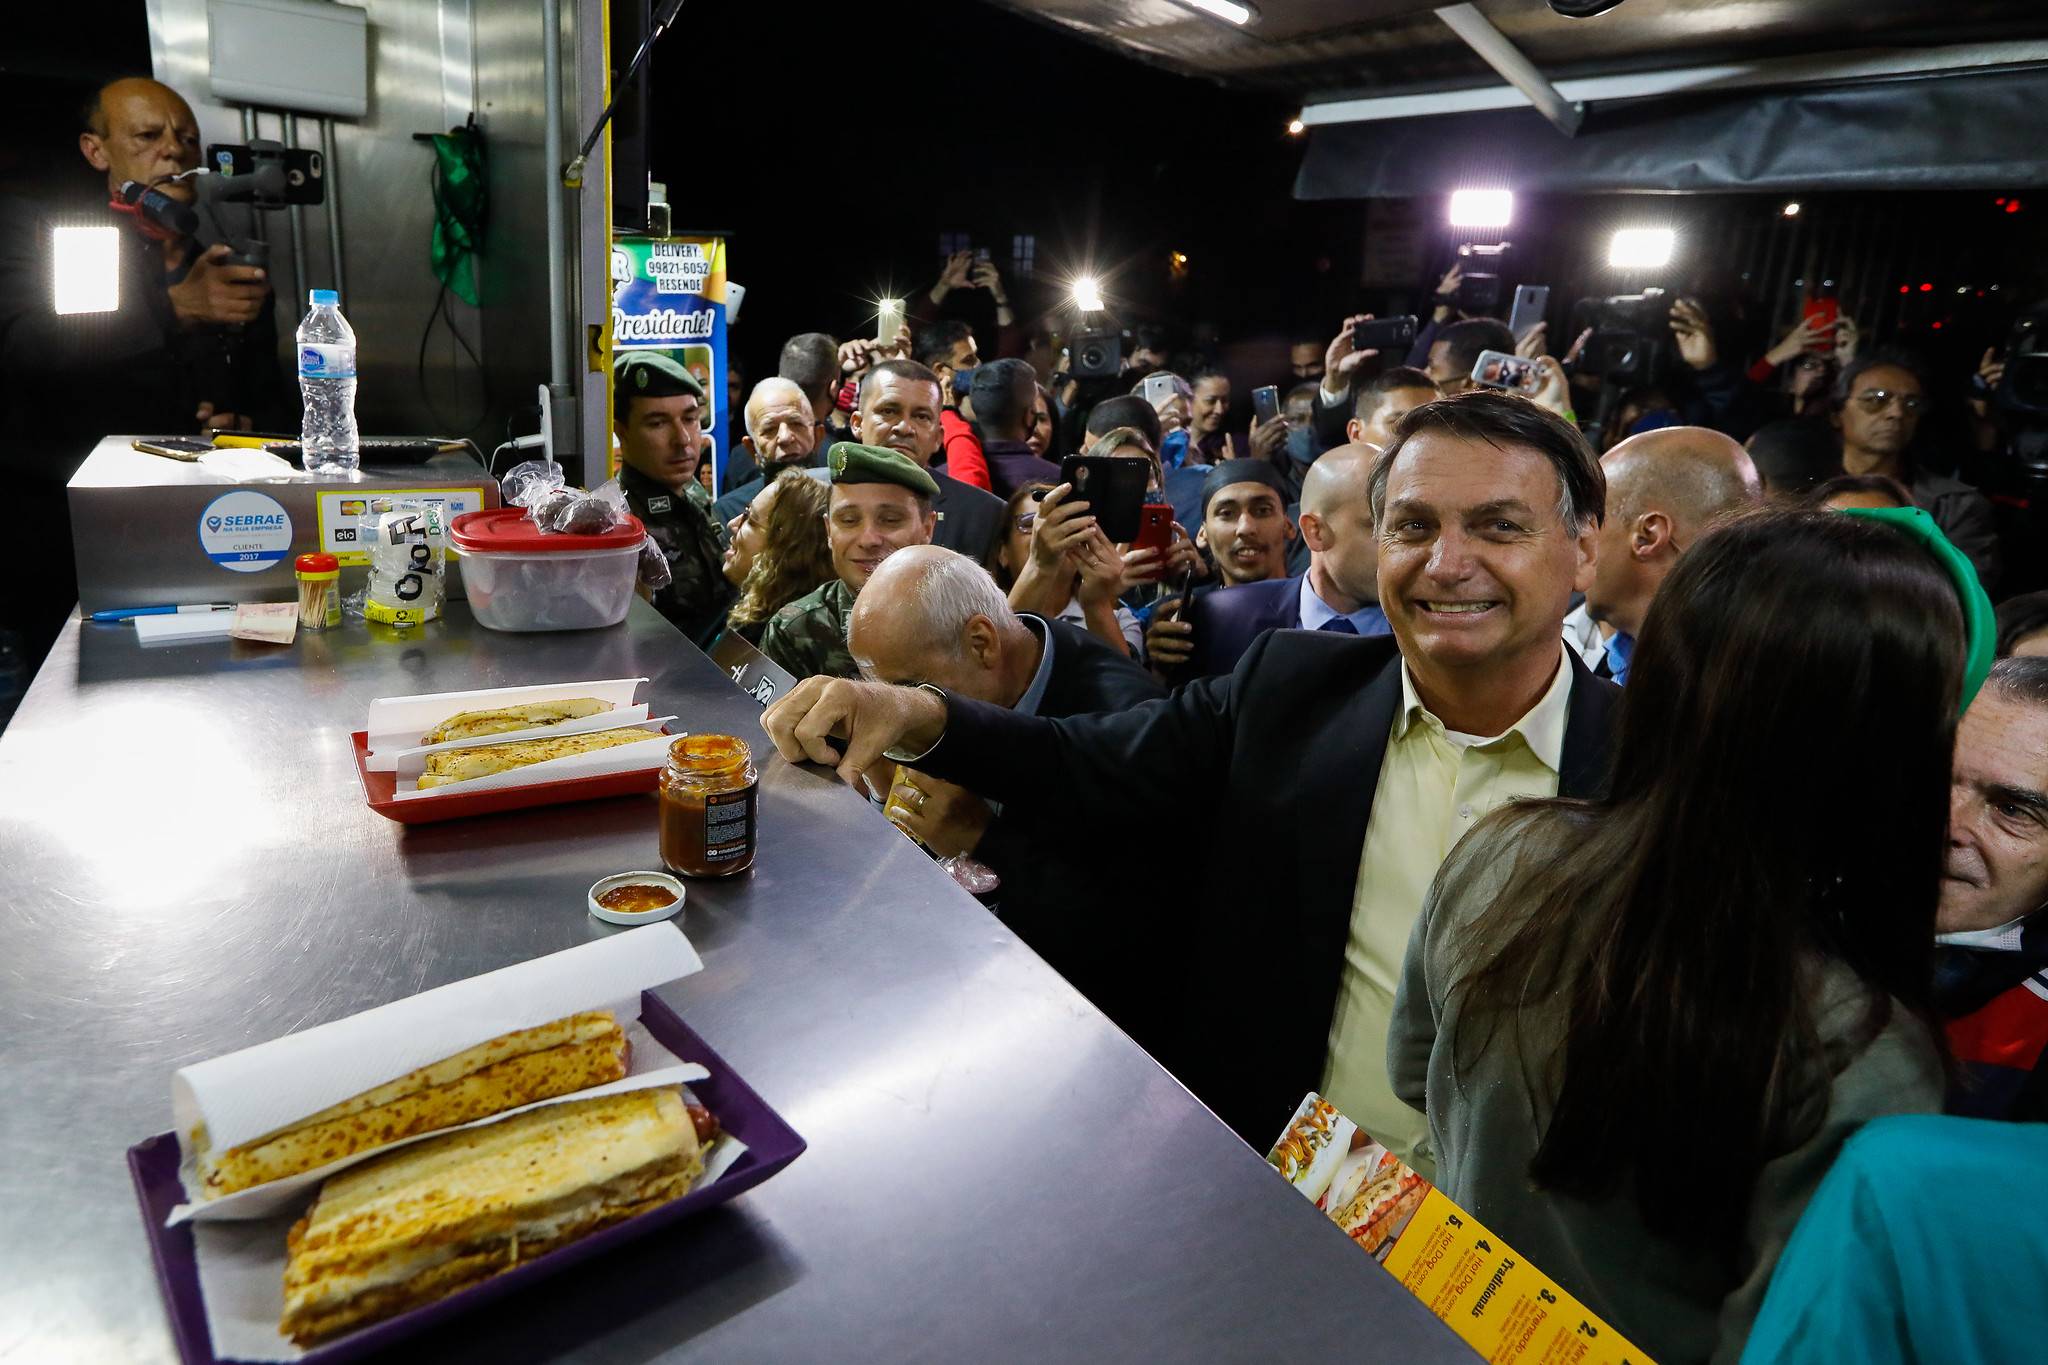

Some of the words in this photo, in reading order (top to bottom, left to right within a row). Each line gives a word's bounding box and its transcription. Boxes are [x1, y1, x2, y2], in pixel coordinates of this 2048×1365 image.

[648, 261, 709, 275] 99821-6052
[612, 311, 711, 336] Presidente!
[224, 514, 285, 526] SEBRAE
[336, 530, 355, 540] elo
[233, 543, 263, 551] CLIENTE
[1445, 1214, 1463, 1229] 5.
[1441, 1232, 1455, 1250] Hot
[1475, 1239, 1491, 1254] 4.
[1427, 1250, 1444, 1270] Dog
[1469, 1257, 1483, 1274] Hot
[1456, 1275, 1473, 1295] Dog
[1471, 1257, 1515, 1318] Tradicionais
[1446, 1295, 1458, 1311] com
[1537, 1288, 1556, 1304] 3.
[1515, 1308, 1548, 1354] Prensado
[1577, 1320, 1598, 1338] 2.
